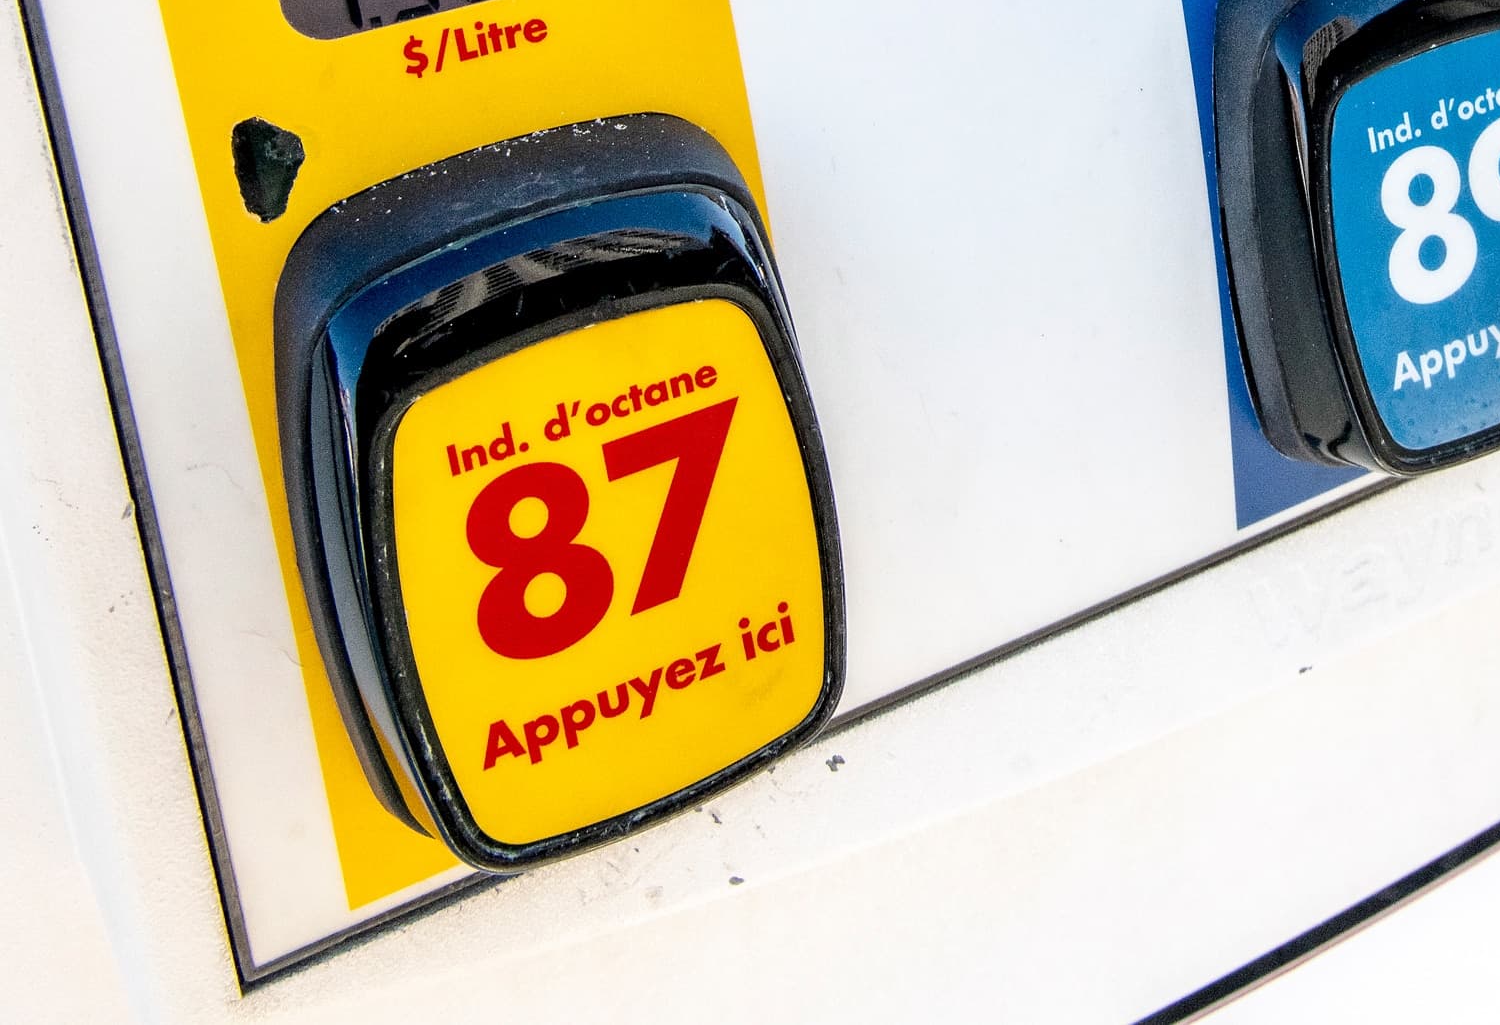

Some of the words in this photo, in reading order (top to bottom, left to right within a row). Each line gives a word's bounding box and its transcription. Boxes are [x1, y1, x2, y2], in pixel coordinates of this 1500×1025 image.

[403, 19, 547, 78] $/Litre
[1368, 113, 1421, 152] Ind.
[447, 422, 529, 476] Ind.
[544, 366, 717, 441] d'octane
[466, 397, 738, 660] 87
[484, 644, 725, 770] Appuyez
[739, 602, 795, 661] ici
